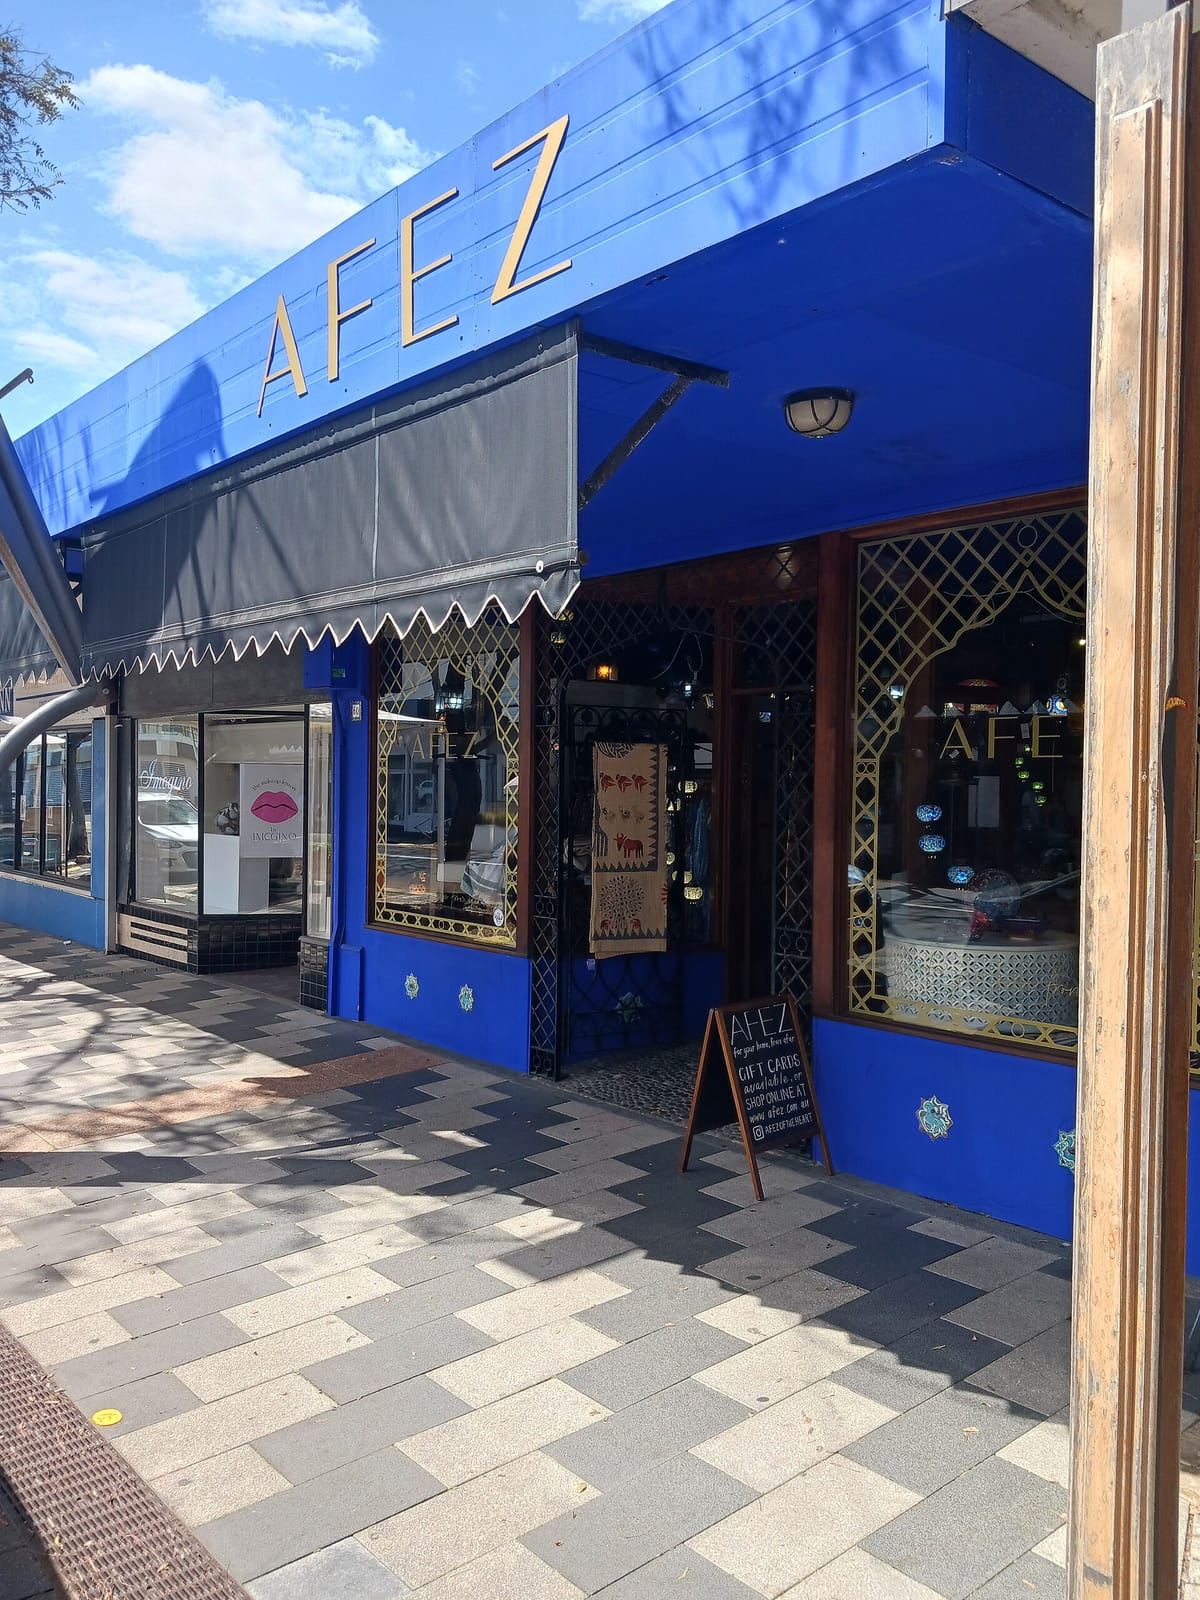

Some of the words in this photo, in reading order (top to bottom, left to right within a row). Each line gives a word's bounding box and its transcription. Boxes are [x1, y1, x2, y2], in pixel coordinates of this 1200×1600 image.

[257, 114, 572, 416] AFEZ
[411, 730, 480, 760] AFEZ
[939, 715, 1083, 760] AFE
[731, 1002, 793, 1046] AFEZ
[743, 1045, 755, 1059] your
[738, 1062, 763, 1082] GIFT
[767, 1053, 801, 1073] CARDS
[793, 1071, 803, 1081] or
[796, 1083, 807, 1097] AT
